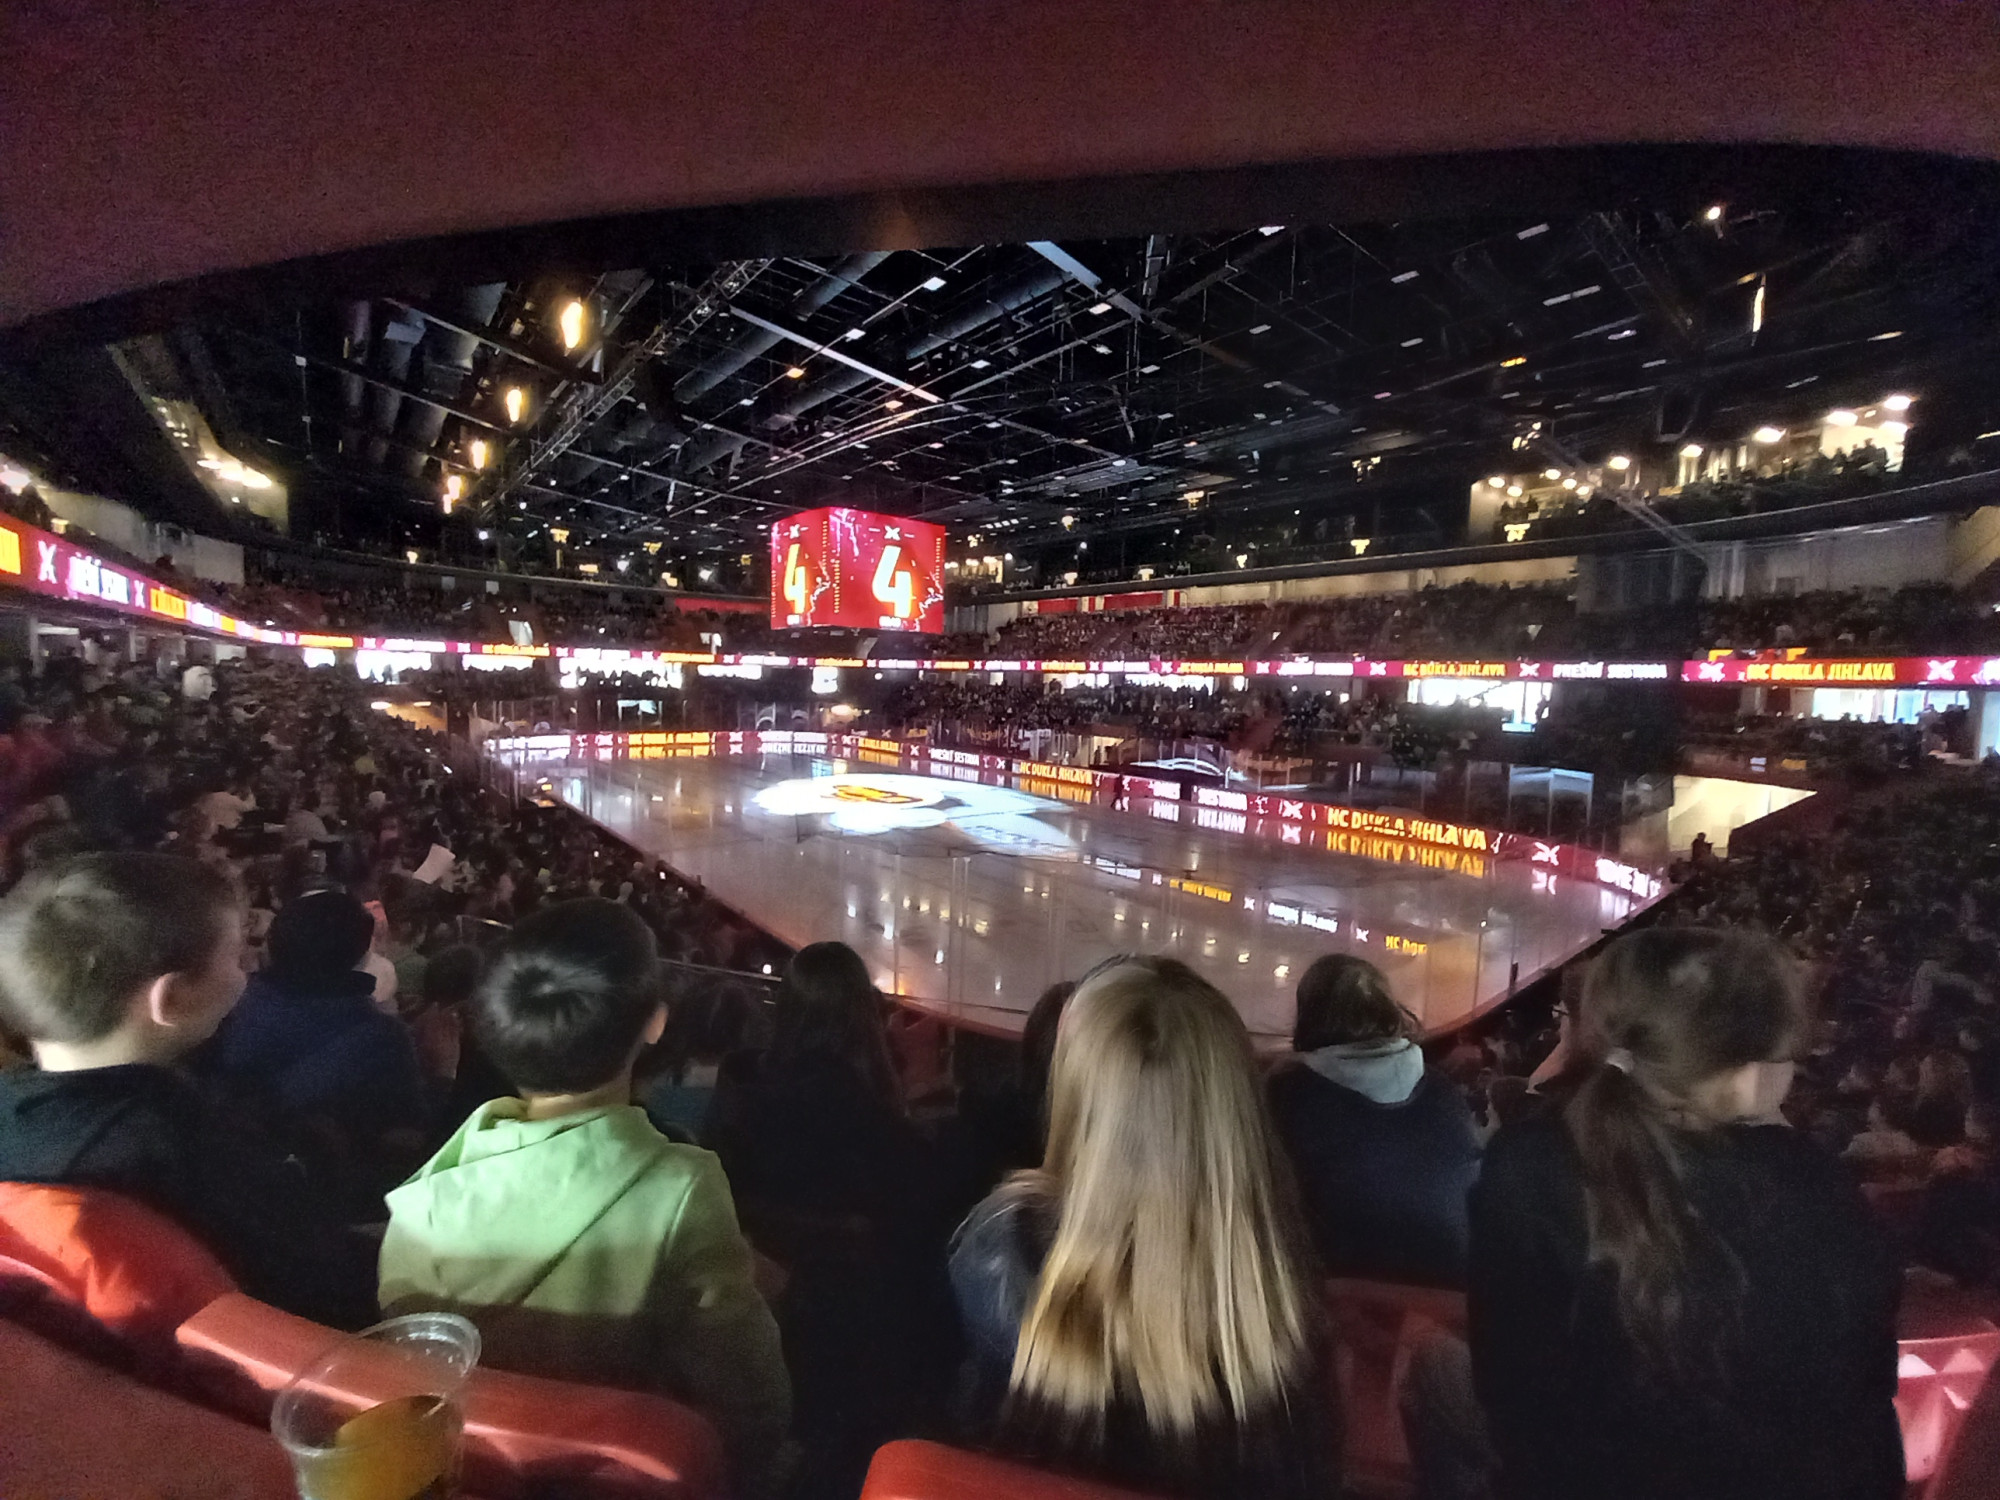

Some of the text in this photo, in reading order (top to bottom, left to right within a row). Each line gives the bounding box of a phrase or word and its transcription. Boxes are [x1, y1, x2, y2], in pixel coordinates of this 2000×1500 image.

[783, 543, 806, 614] 4
[872, 545, 913, 618] 4
[1827, 662, 1895, 680] JIHLAVA
[1020, 761, 1031, 775] HC
[1031, 763, 1057, 779] DUKLA
[1327, 807, 1487, 850] HC DUKLA JIHLAVA
